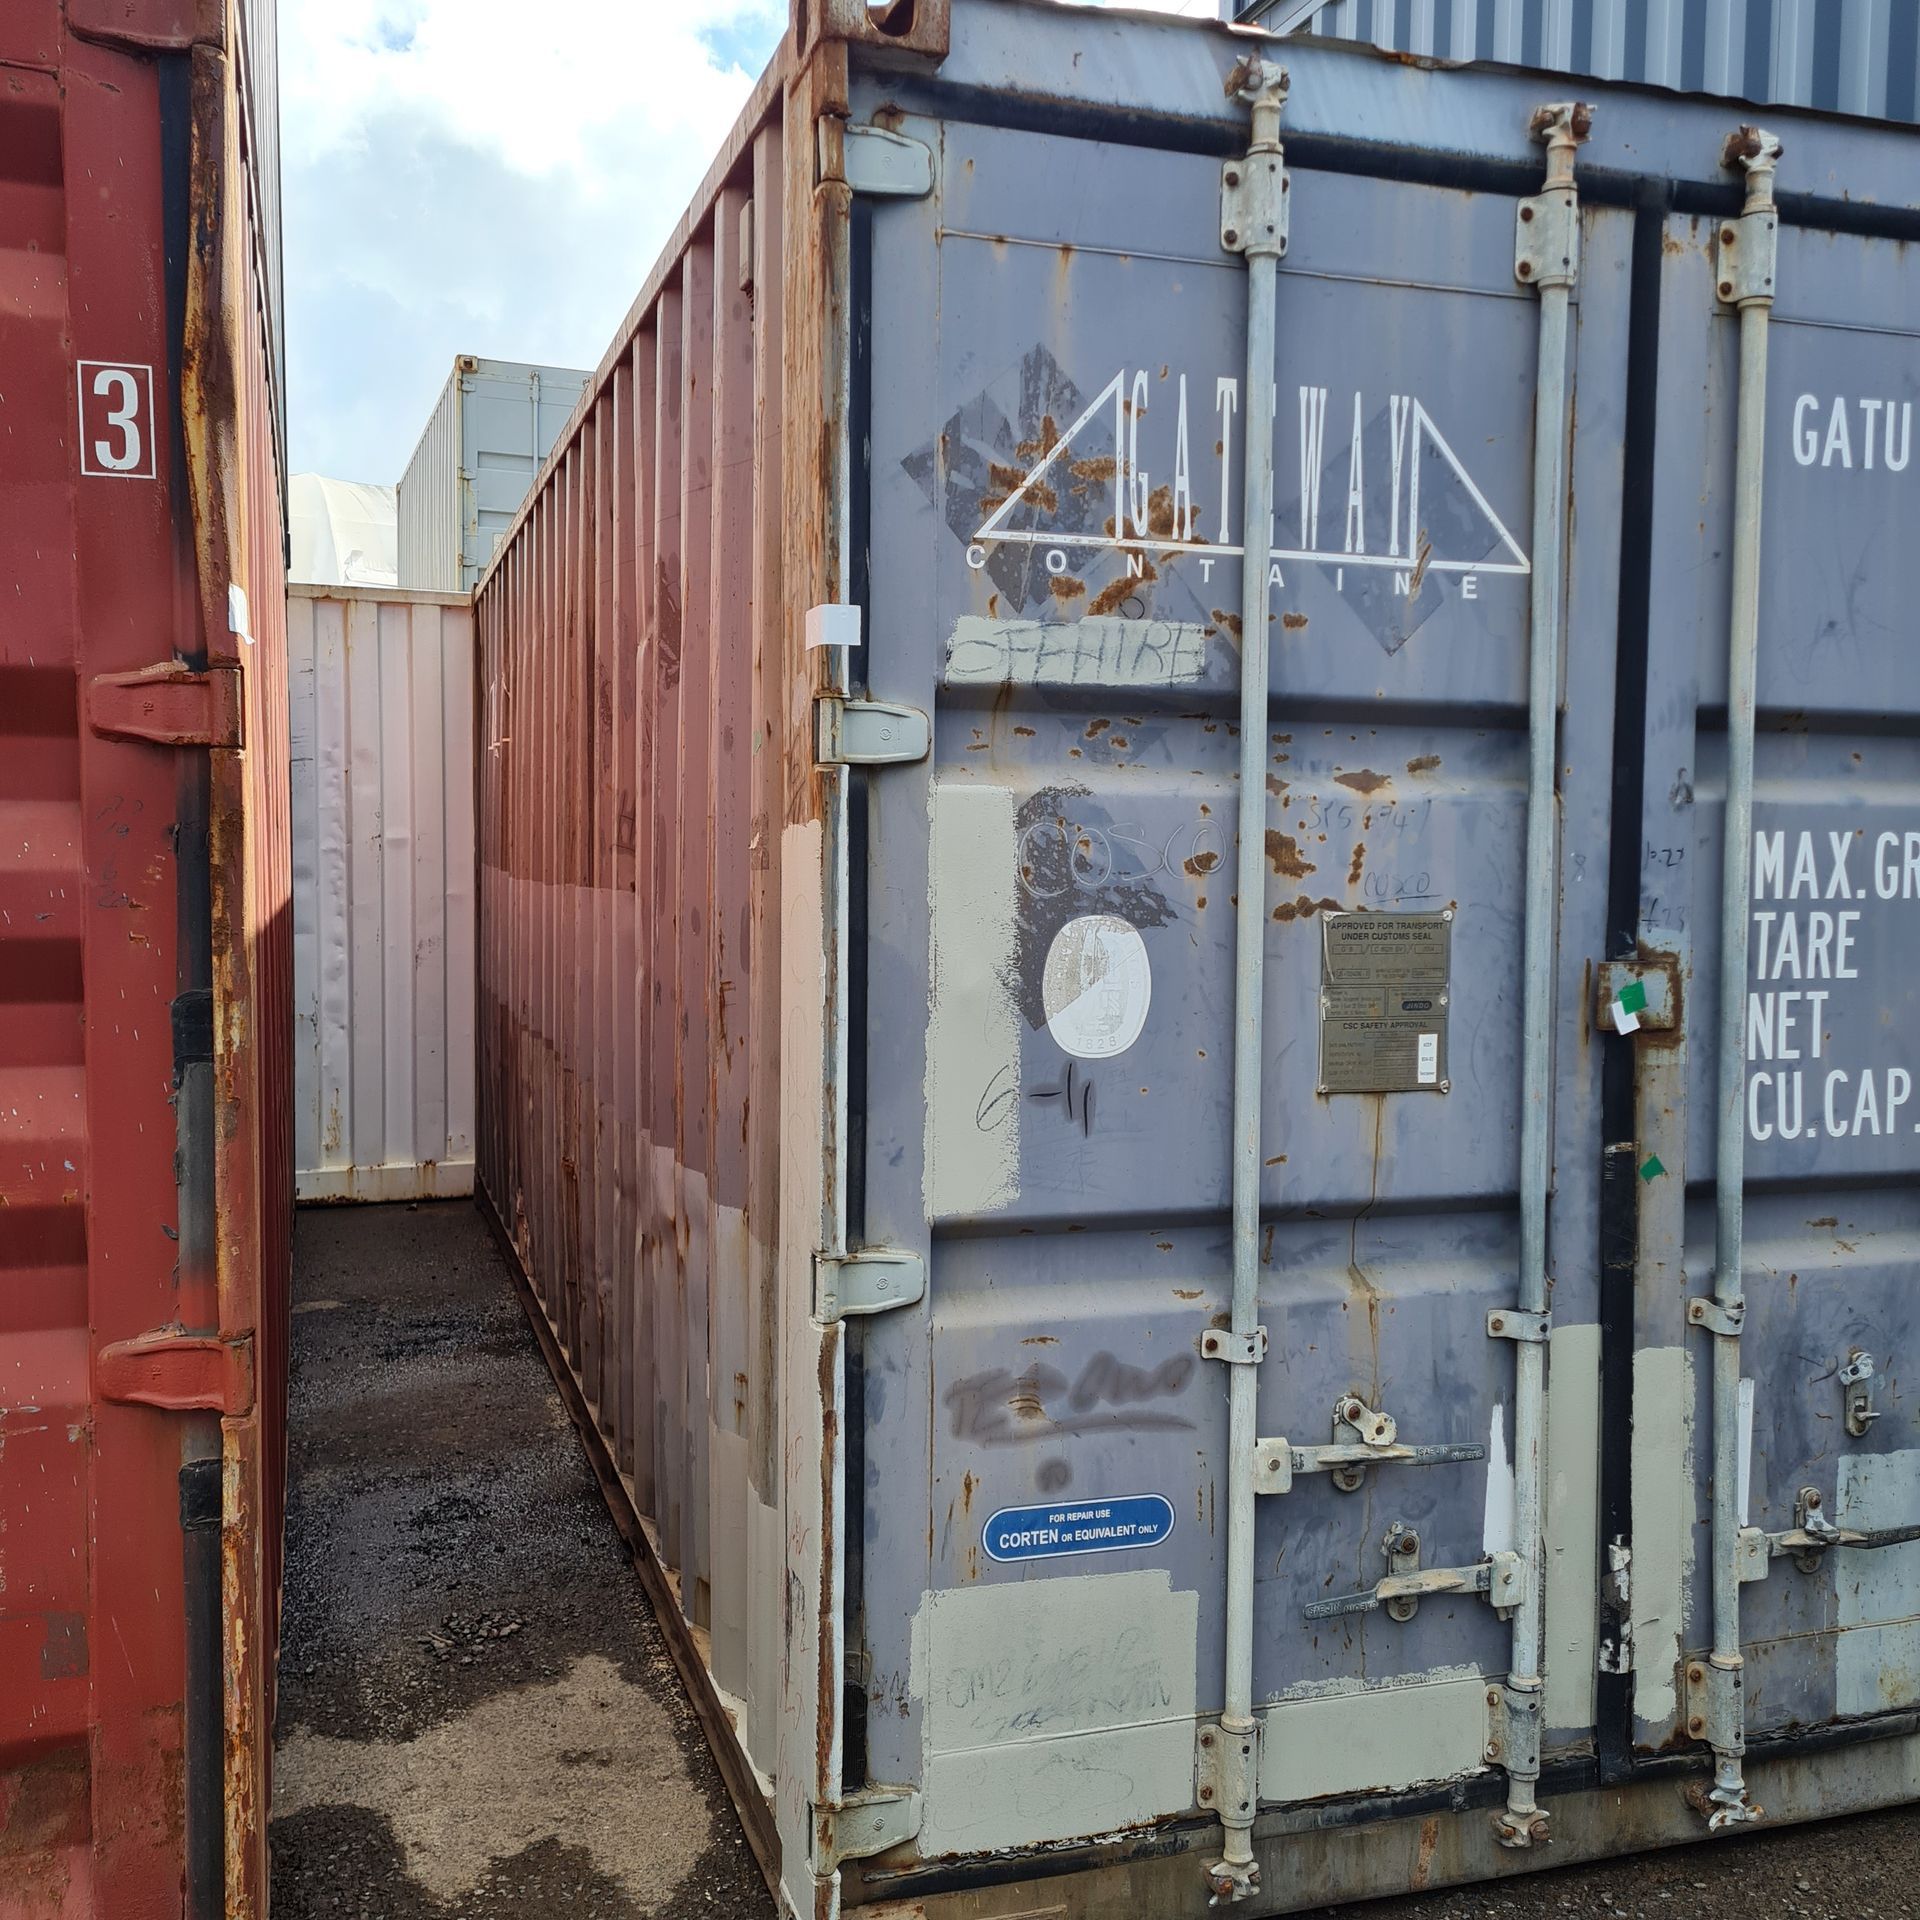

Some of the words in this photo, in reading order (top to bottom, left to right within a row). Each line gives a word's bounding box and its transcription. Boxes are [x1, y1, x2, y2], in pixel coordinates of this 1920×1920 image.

[92, 369, 141, 471] 3
[1792, 393, 1911, 472] GATU
[1129, 370, 1411, 556] GATWAY
[1331, 922, 1376, 931] APPROVED
[1378, 922, 1394, 930] FOR
[1396, 921, 1443, 930] TRANSPORT
[1341, 932, 1370, 941] UNDER
[1372, 932, 1410, 941] CUSTOMS
[1412, 932, 1432, 941] SEAL
[1753, 911, 1861, 980] TARE
[1343, 1022, 1359, 1031] CSC
[1361, 1021, 1388, 1030] SAFETY
[1390, 1020, 1428, 1029] APPROVAL
[1748, 991, 1829, 1060] NET
[999, 1529, 1059, 1549] CORTEN
[1061, 1533, 1073, 1543] OR
[1075, 1524, 1137, 1541] EQUIVALENT
[1138, 1524, 1159, 1535] ONLY
[1049, 1514, 1065, 1524] FOR
[1067, 1511, 1094, 1522] REPAIR
[1095, 1509, 1111, 1519] USE
